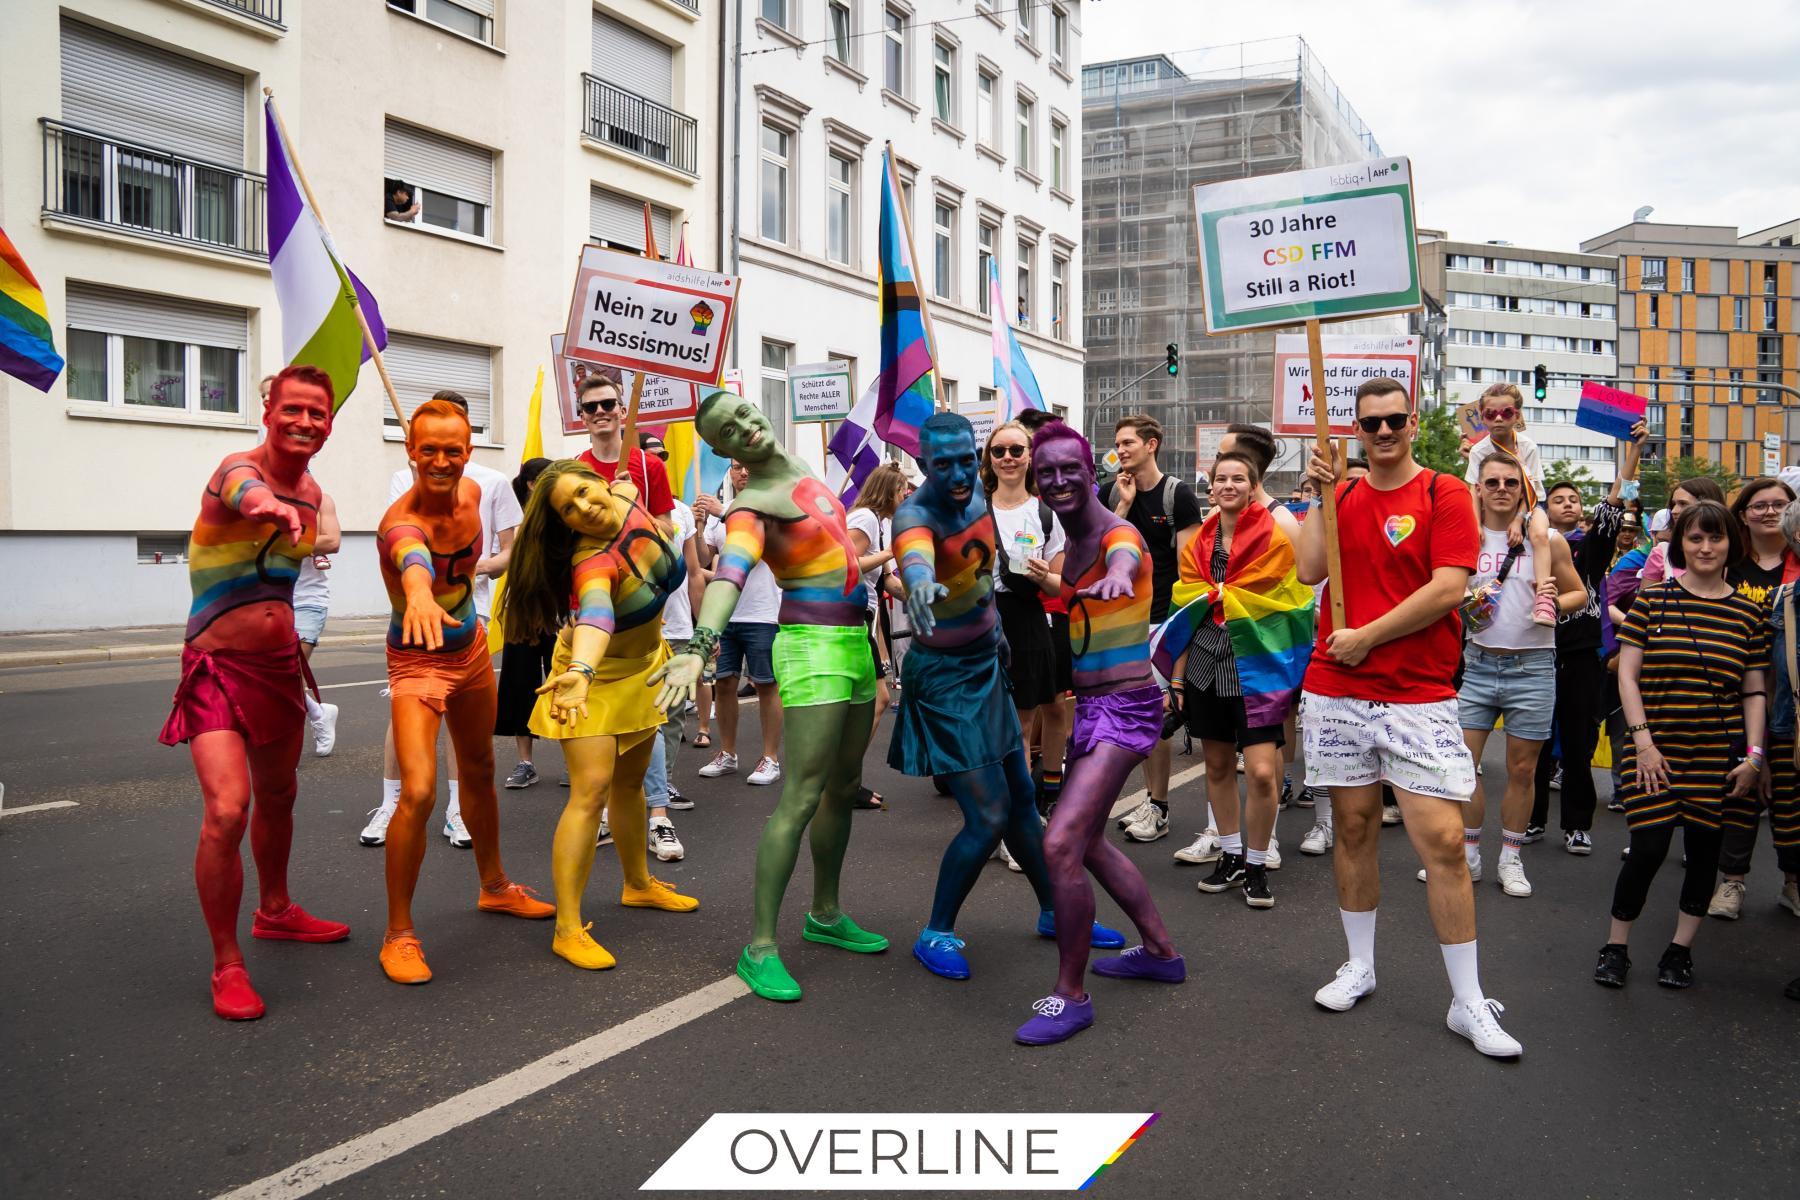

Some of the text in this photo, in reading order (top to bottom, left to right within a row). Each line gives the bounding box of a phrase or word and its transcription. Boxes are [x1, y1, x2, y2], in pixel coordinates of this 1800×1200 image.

[1373, 168, 1389, 177] AHF
[1249, 213, 1337, 238] 30 Jahre
[1263, 239, 1356, 266] CSD FFM
[666, 272, 723, 288] aidshilfe AHF
[1246, 269, 1356, 298] Still a Riot!
[594, 290, 678, 326] Nein zu
[589, 319, 710, 364] Rassismus!
[1288, 366, 1308, 377] Wir
[1341, 366, 1358, 378] für
[1361, 366, 1386, 379] dich
[1390, 367, 1410, 379] da.
[645, 377, 660, 386] AHF
[801, 379, 836, 388] Schützt die
[799, 390, 841, 401] Rechte ALLER
[638, 398, 673, 410] EHR ZEIT
[804, 402, 839, 412] Menschen!
[1298, 405, 1354, 417] Frakfurt
